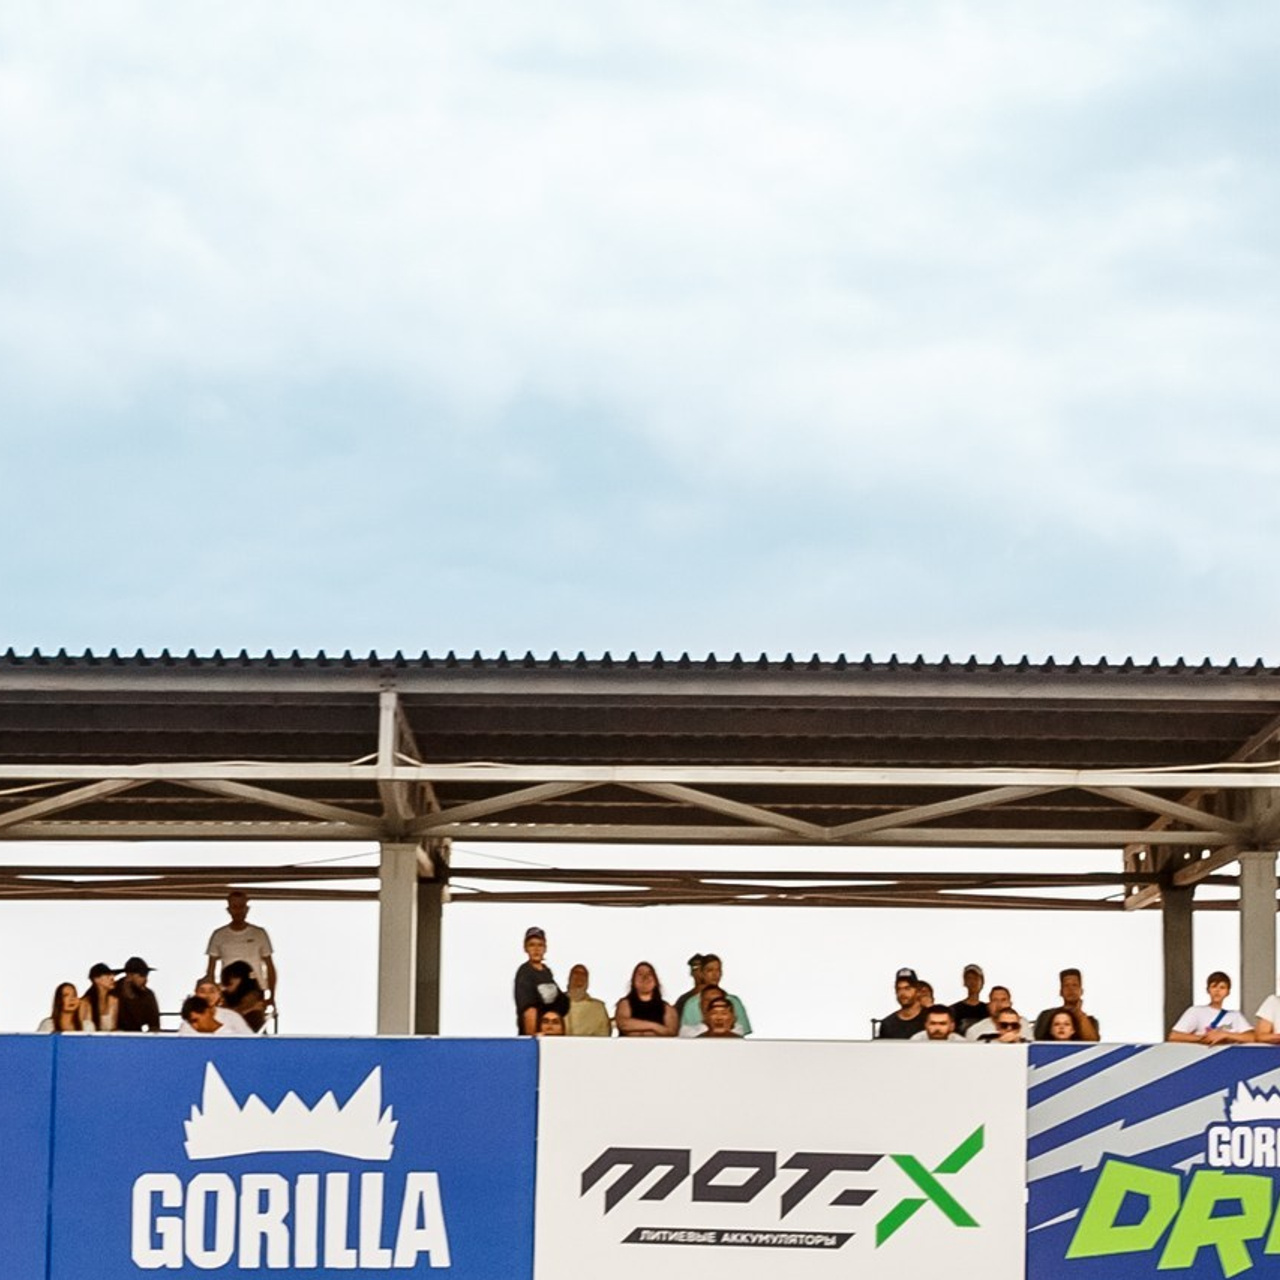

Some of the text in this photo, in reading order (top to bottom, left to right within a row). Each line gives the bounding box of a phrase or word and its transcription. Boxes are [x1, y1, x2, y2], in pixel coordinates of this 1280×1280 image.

[130, 1171, 452, 1269] GORILLA
[639, 1229, 838, 1247] ЛИТИЕВЫЕ АККУМУЛЯТОРЫ
